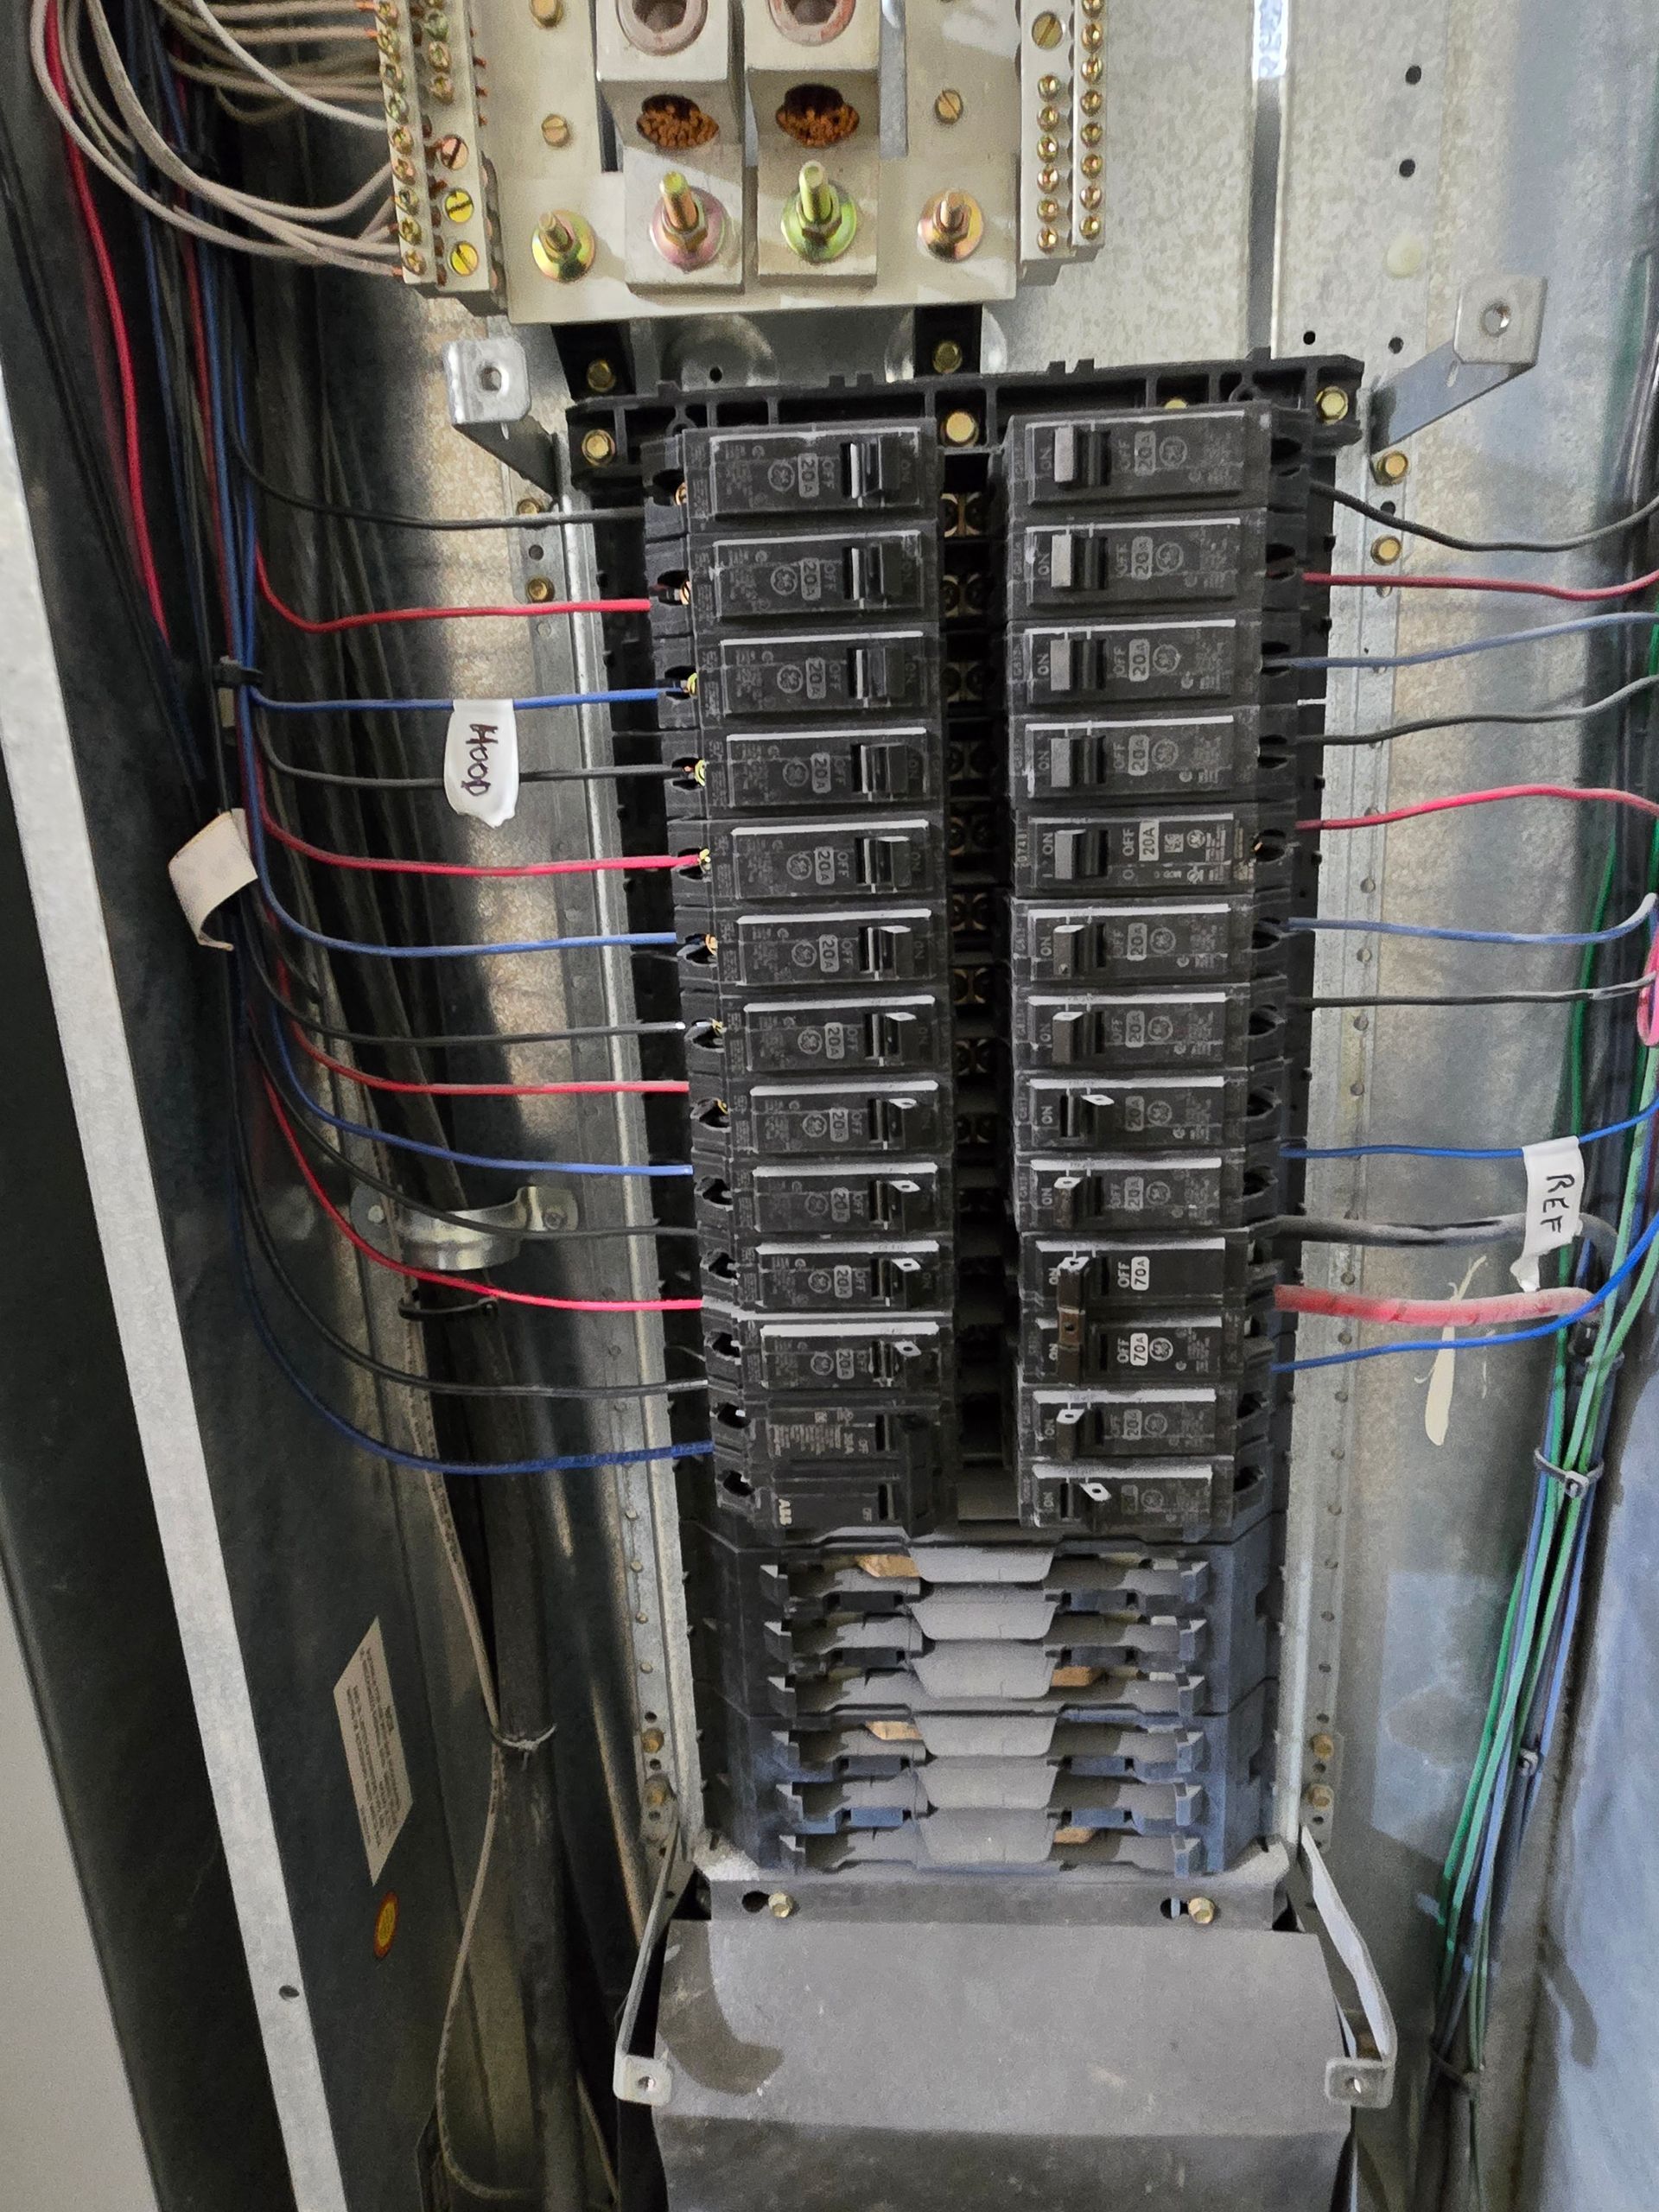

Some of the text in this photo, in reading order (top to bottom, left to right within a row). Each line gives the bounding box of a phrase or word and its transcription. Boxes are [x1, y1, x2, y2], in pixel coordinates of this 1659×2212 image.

[1039, 448, 1052, 471] ON
[801, 459, 815, 493] 20A
[822, 461, 836, 490] OFF
[804, 561, 817, 596] 20A
[823, 564, 837, 593] OFF
[1037, 653, 1049, 676] ON
[1113, 645, 1127, 676] OFF
[1132, 642, 1147, 676] 20A
[809, 663, 823, 696] 20A
[830, 664, 842, 691] OFF
[1037, 750, 1050, 771] ON
[1113, 742, 1126, 771] OFF
[1133, 739, 1146, 771] 20A
[814, 759, 827, 789] 20A
[1042, 832, 1054, 855] ON
[1122, 829, 1135, 857] OFF
[1142, 826, 1156, 855] 20A
[818, 851, 831, 881] 20A
[836, 851, 850, 879] OFF
[911, 853, 922, 872] ON
[822, 939, 835, 969] 20A
[841, 939, 855, 965] OFF
[913, 940, 925, 960] ON
[1040, 936, 1052, 957] ON
[1131, 926, 1143, 956] 20A
[828, 1027, 840, 1056] 20A
[846, 1027, 859, 1052] OFF
[1039, 1023, 1052, 1042] ON
[1128, 1014, 1141, 1043] 20A
[832, 1111, 844, 1139] 20A
[850, 1110, 862, 1136] OFF
[1041, 1105, 1053, 1125] ON
[1128, 1098, 1141, 1128] 20A
[834, 1192, 847, 1219] 20A
[852, 1192, 865, 1217] OFF
[1041, 1187, 1053, 1206] ON
[1128, 1179, 1140, 1206] 20A
[1540, 1173, 1575, 1233] REF
[836, 1269, 849, 1295] 20A
[855, 1268, 867, 1293] OFF
[1117, 1262, 1130, 1288] OFF
[1134, 1260, 1147, 1286] 70A
[1116, 1338, 1129, 1363] OFF
[1133, 1337, 1145, 1362] 70A
[838, 1352, 852, 1376] 20A
[1044, 1418, 1056, 1437] ON
[859, 1439, 868, 1454] OFF
[779, 1498, 792, 1526] ABB
[862, 1507, 873, 1522] OFF
